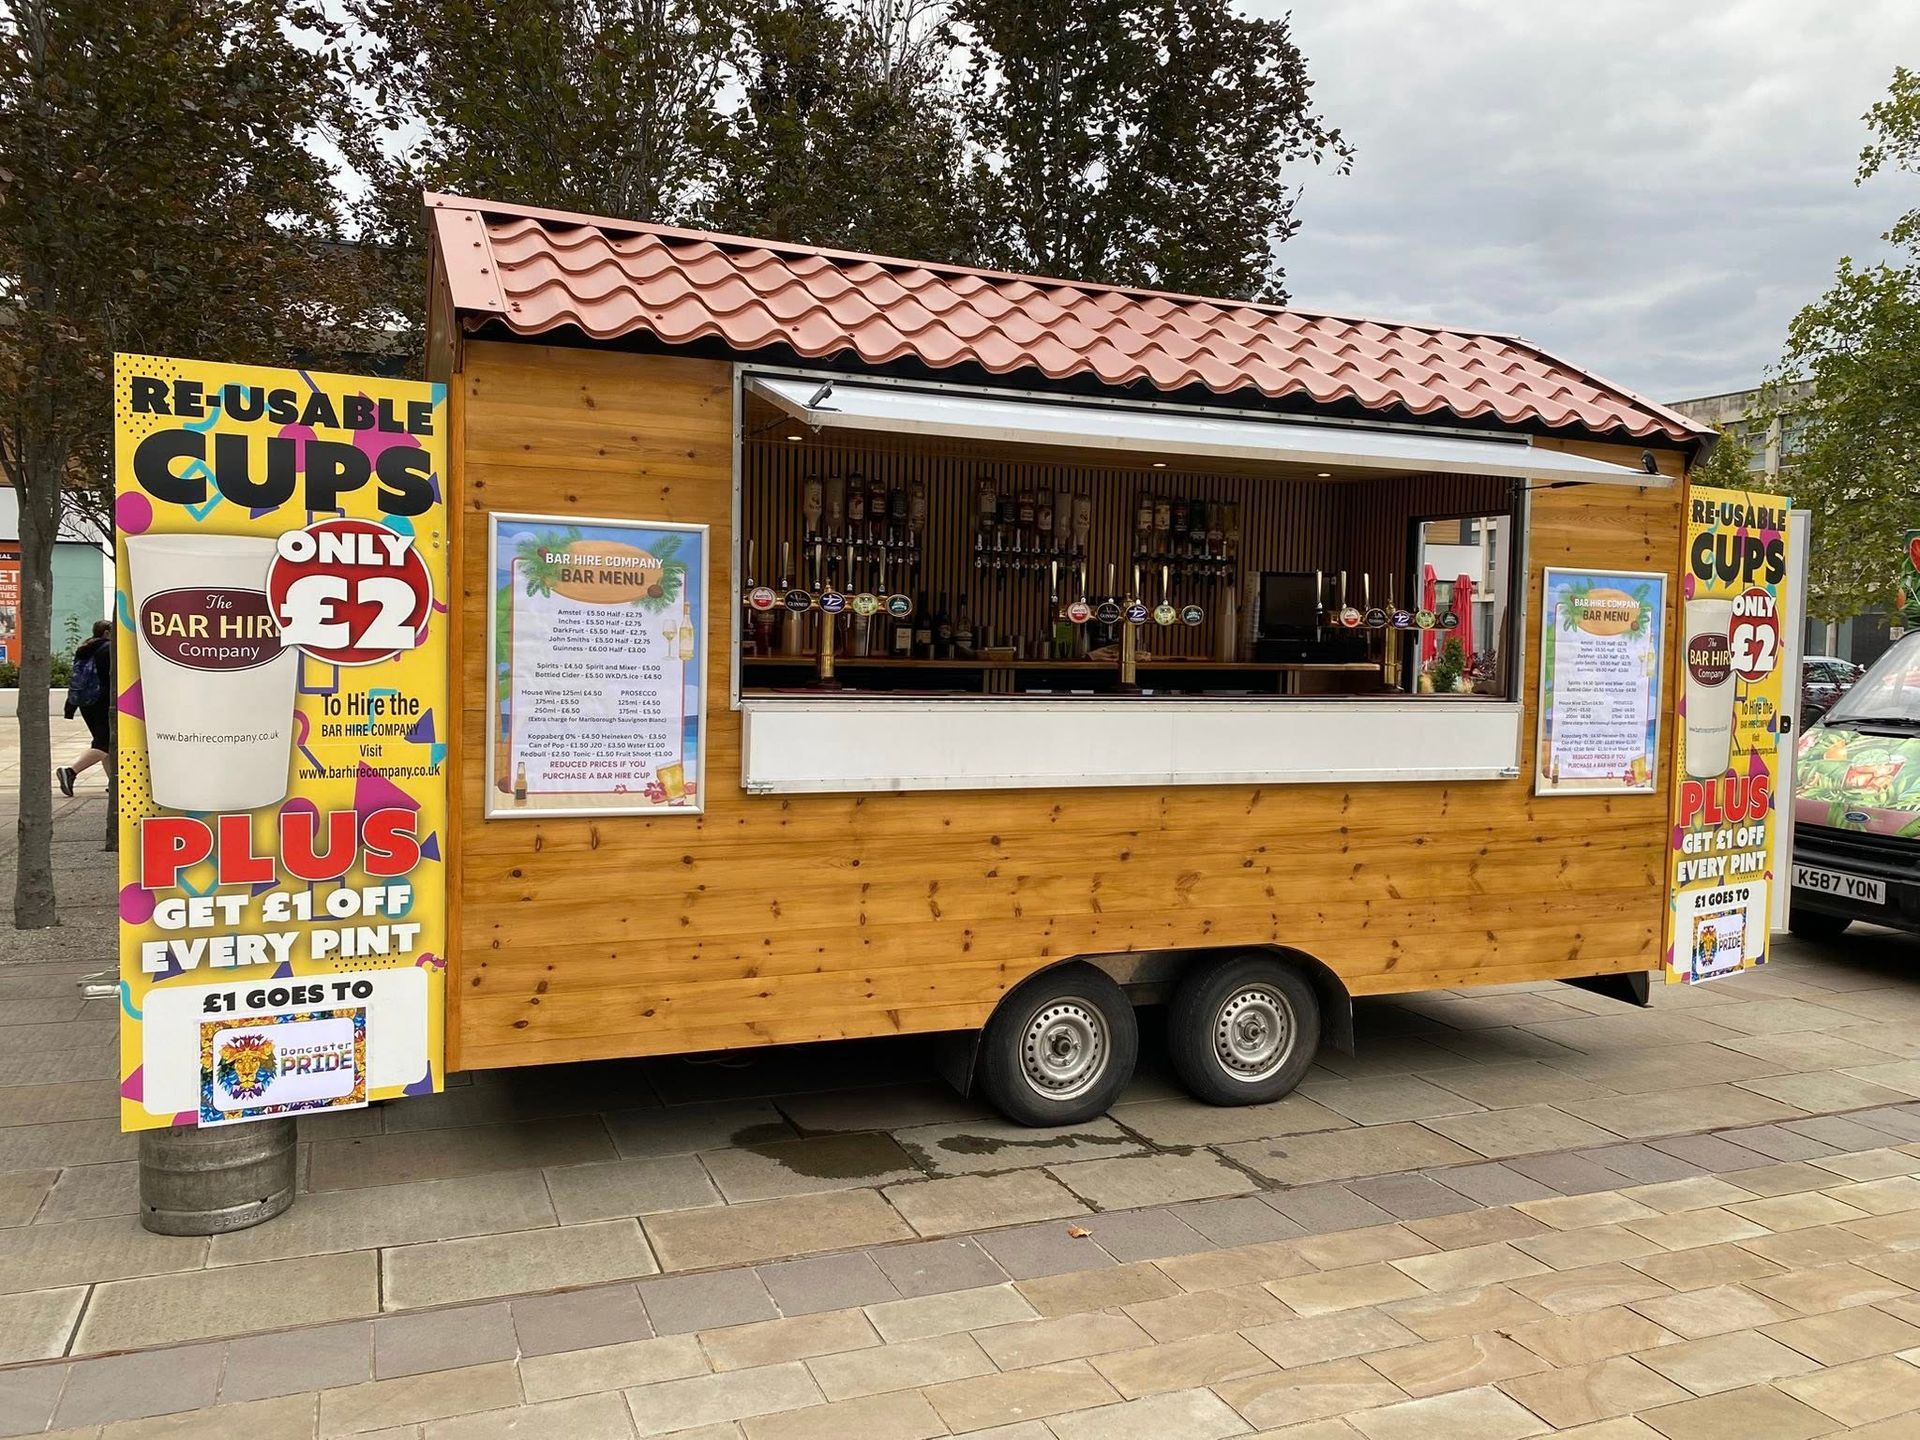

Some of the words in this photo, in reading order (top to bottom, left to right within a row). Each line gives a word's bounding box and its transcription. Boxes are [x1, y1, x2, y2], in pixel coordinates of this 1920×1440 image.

[130, 376, 434, 436] RE-USABLE
[133, 429, 435, 517] CUPS
[1692, 499, 1786, 531] RE-USABLE
[277, 530, 415, 566] ONLY
[1691, 532, 1785, 585] CUPS
[545, 553, 571, 565] BAR
[574, 555, 601, 566] HIRE
[605, 556, 663, 569] COMPANY
[561, 568, 594, 584] BAR
[600, 569, 645, 586] MENU
[205, 594, 233, 609] The
[280, 575, 416, 649] £2
[1574, 598, 1588, 607] BAR
[1590, 599, 1606, 607] HIRE
[1607, 600, 1640, 609] COMPANY
[1732, 595, 1776, 618] ONLY
[150, 611, 209, 638] BAR
[220, 615, 280, 638] HIR
[1583, 610, 1602, 621] BAR
[1603, 611, 1630, 622] MENU
[179, 642, 260, 660] Company
[1690, 649, 1709, 665] BAR
[1712, 650, 1732, 666] HIR
[1729, 623, 1776, 672] £2
[586, 663, 604, 671] Spirit
[1698, 668, 1724, 680] Company
[321, 693, 341, 716] To
[347, 691, 386, 716] Hire
[389, 693, 420, 715] the
[156, 730, 280, 744] www.barhirecompany.co.uk
[321, 723, 343, 737] BAR
[344, 723, 369, 737] HIRE
[370, 722, 420, 737] COMPANY
[359, 744, 382, 758] Visit
[299, 764, 441, 780] www.barhirecompany.co.uk
[629, 760, 646, 768] YOU
[543, 772, 587, 780] PURCHASE
[1680, 774, 1770, 829] PLUS
[140, 807, 422, 890] PLUS
[1682, 829, 1713, 854] GET
[1716, 828, 1733, 849] £1
[1737, 825, 1765, 847] OFF
[1677, 855, 1726, 882] EVERY
[1730, 851, 1767, 876] PINT
[1798, 868, 1841, 892] K587
[1845, 877, 1878, 900] YON
[152, 894, 248, 930] GET
[262, 891, 311, 923] £1
[325, 884, 412, 918] OFF
[1694, 896, 1707, 908] £1
[1708, 890, 1735, 907] GOES
[1735, 888, 1749, 902] TO
[141, 931, 302, 974] EVERY
[310, 923, 421, 959] PINT
[1719, 935, 1741, 952] PRIDE
[202, 991, 236, 1013] £1
[245, 985, 328, 1010] GOES
[331, 979, 373, 1003] TO
[280, 1041, 352, 1056] Doncaster
[280, 1049, 353, 1077] PRIDE
